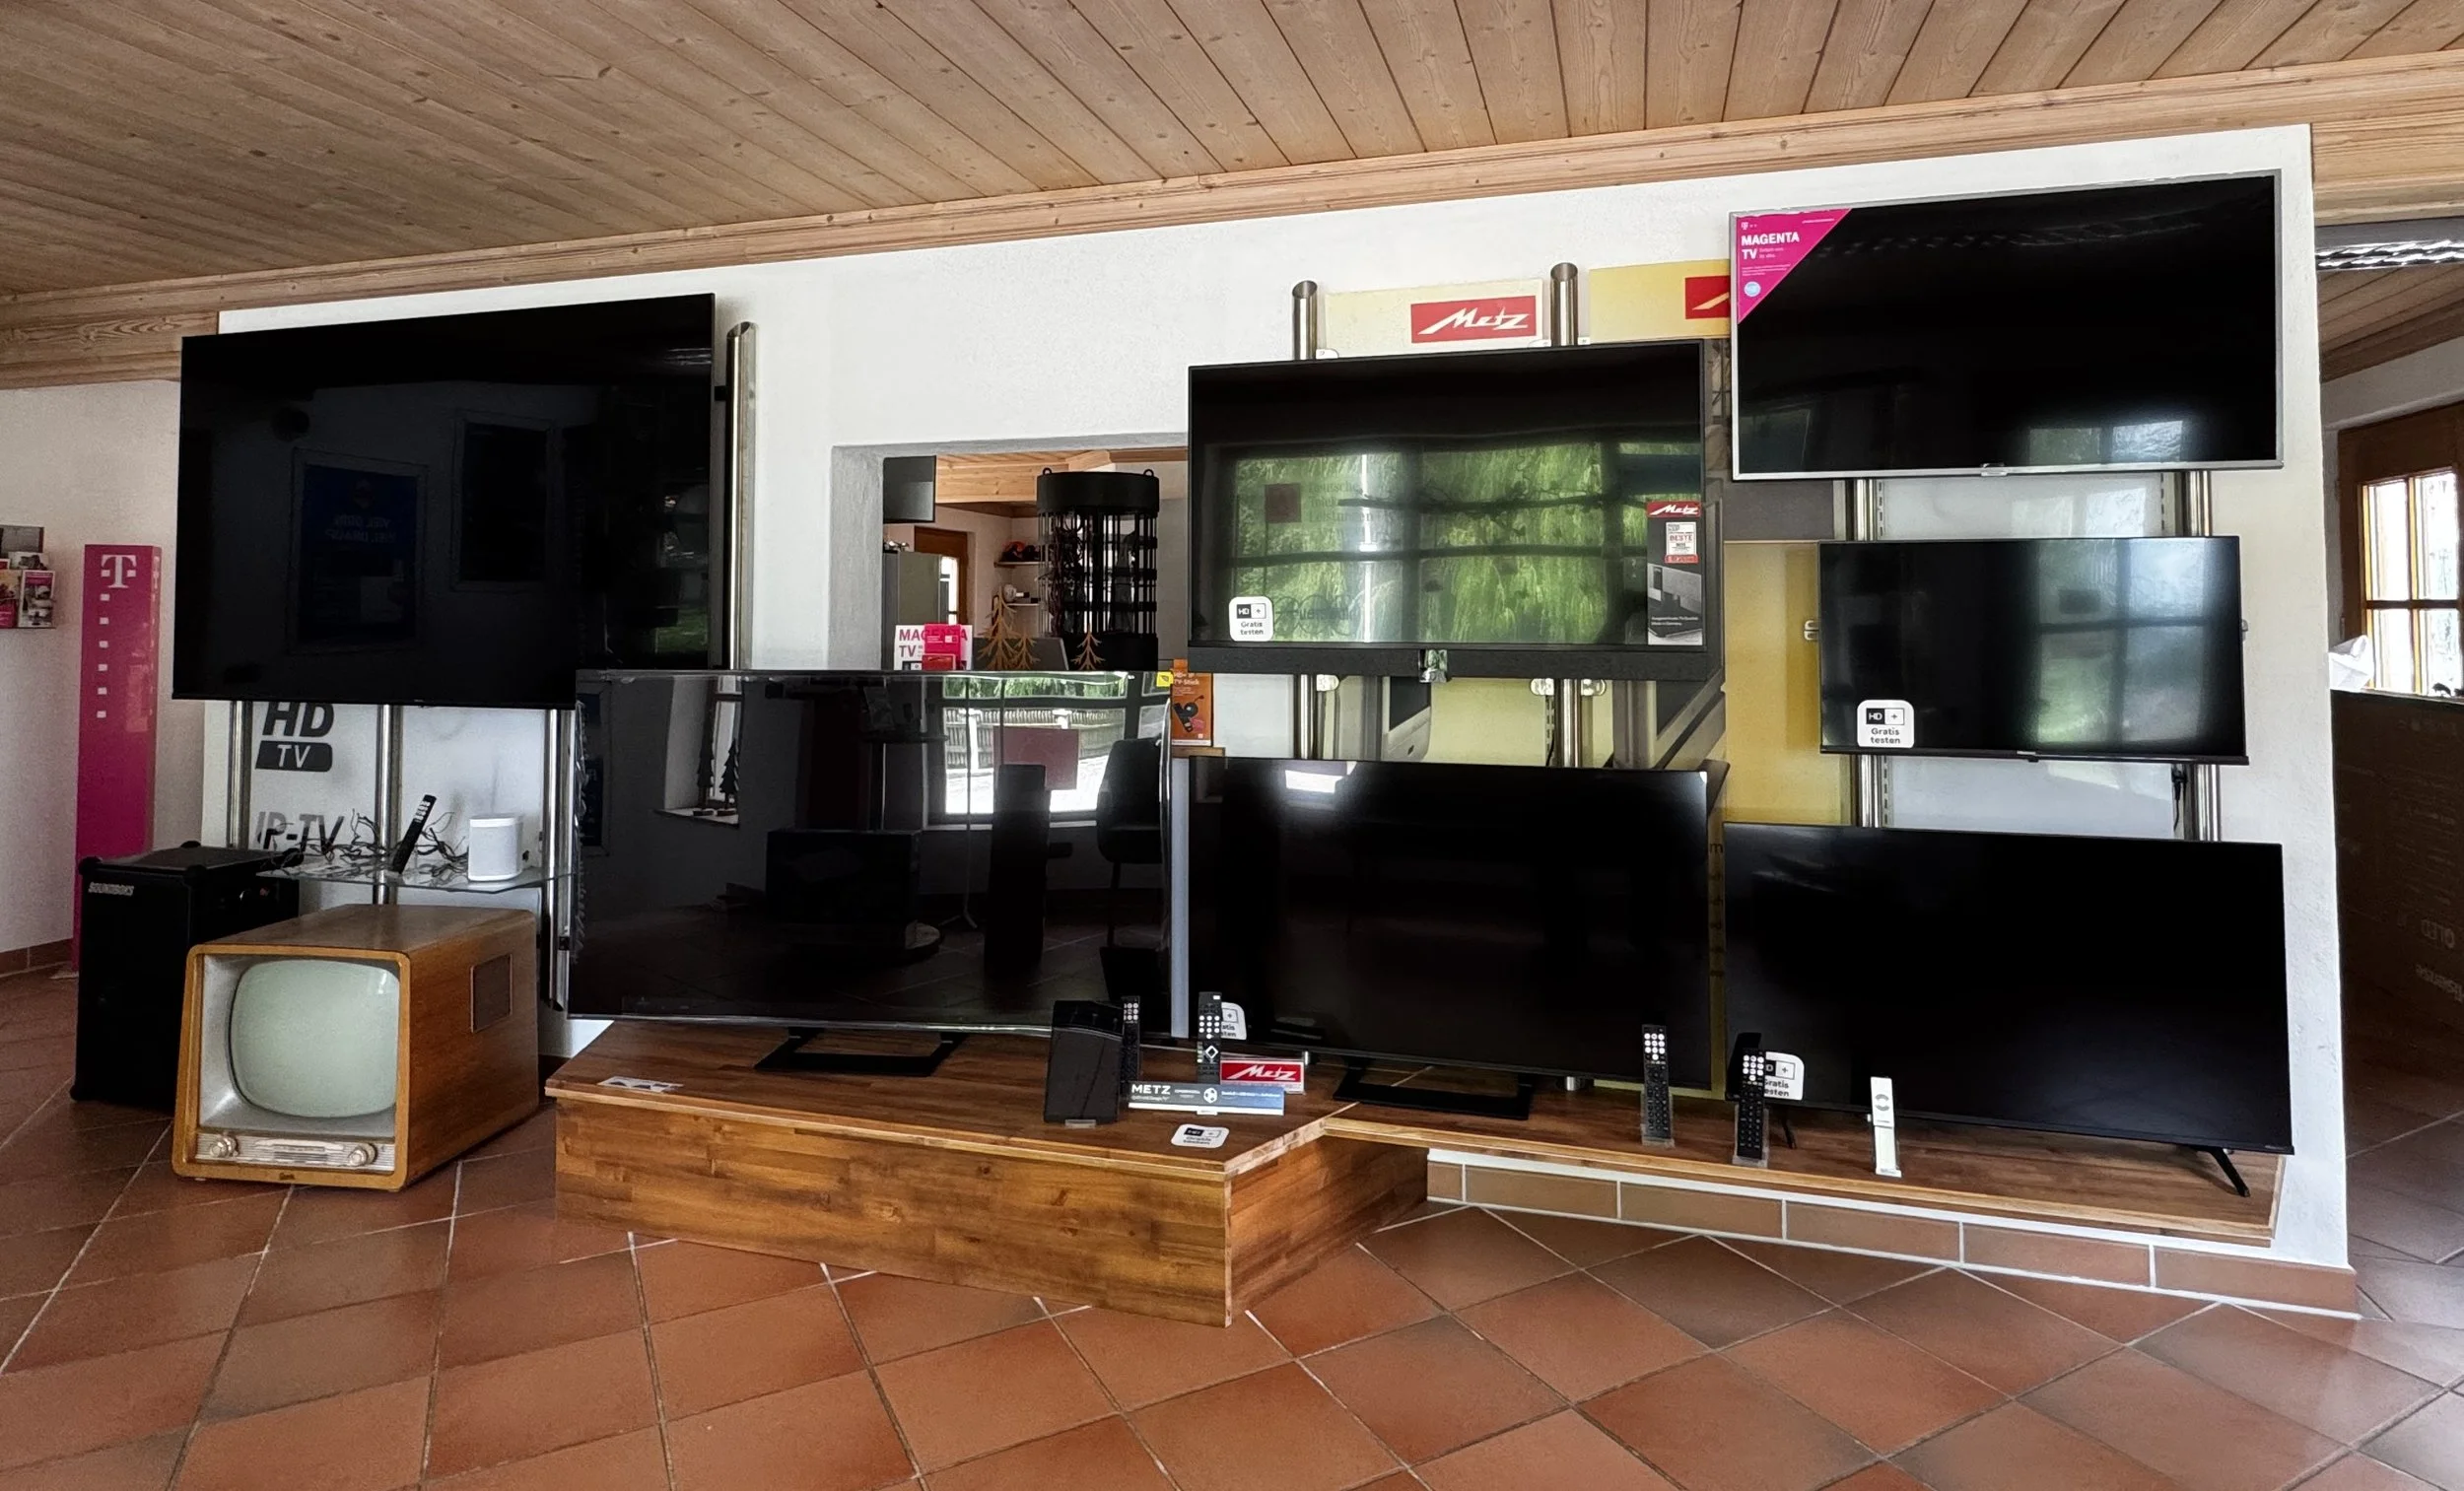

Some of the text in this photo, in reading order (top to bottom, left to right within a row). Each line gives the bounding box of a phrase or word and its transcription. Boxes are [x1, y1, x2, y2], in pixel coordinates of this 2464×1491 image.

[1741, 232, 1800, 246] MAGENTA
[1742, 248, 1757, 260] TV
[1417, 305, 1530, 336] Metz
[1649, 504, 1699, 515] Metz
[101, 554, 137, 589] T
[899, 644, 917, 657] TV
[262, 701, 334, 737] HD
[1871, 727, 1901, 736] Gratis
[277, 744, 311, 769] TV
[253, 811, 345, 855] IP-TV
[1225, 1064, 1297, 1081] Metz
[1131, 1084, 1171, 1095] METZ
[1764, 1088, 1789, 1097] esten
